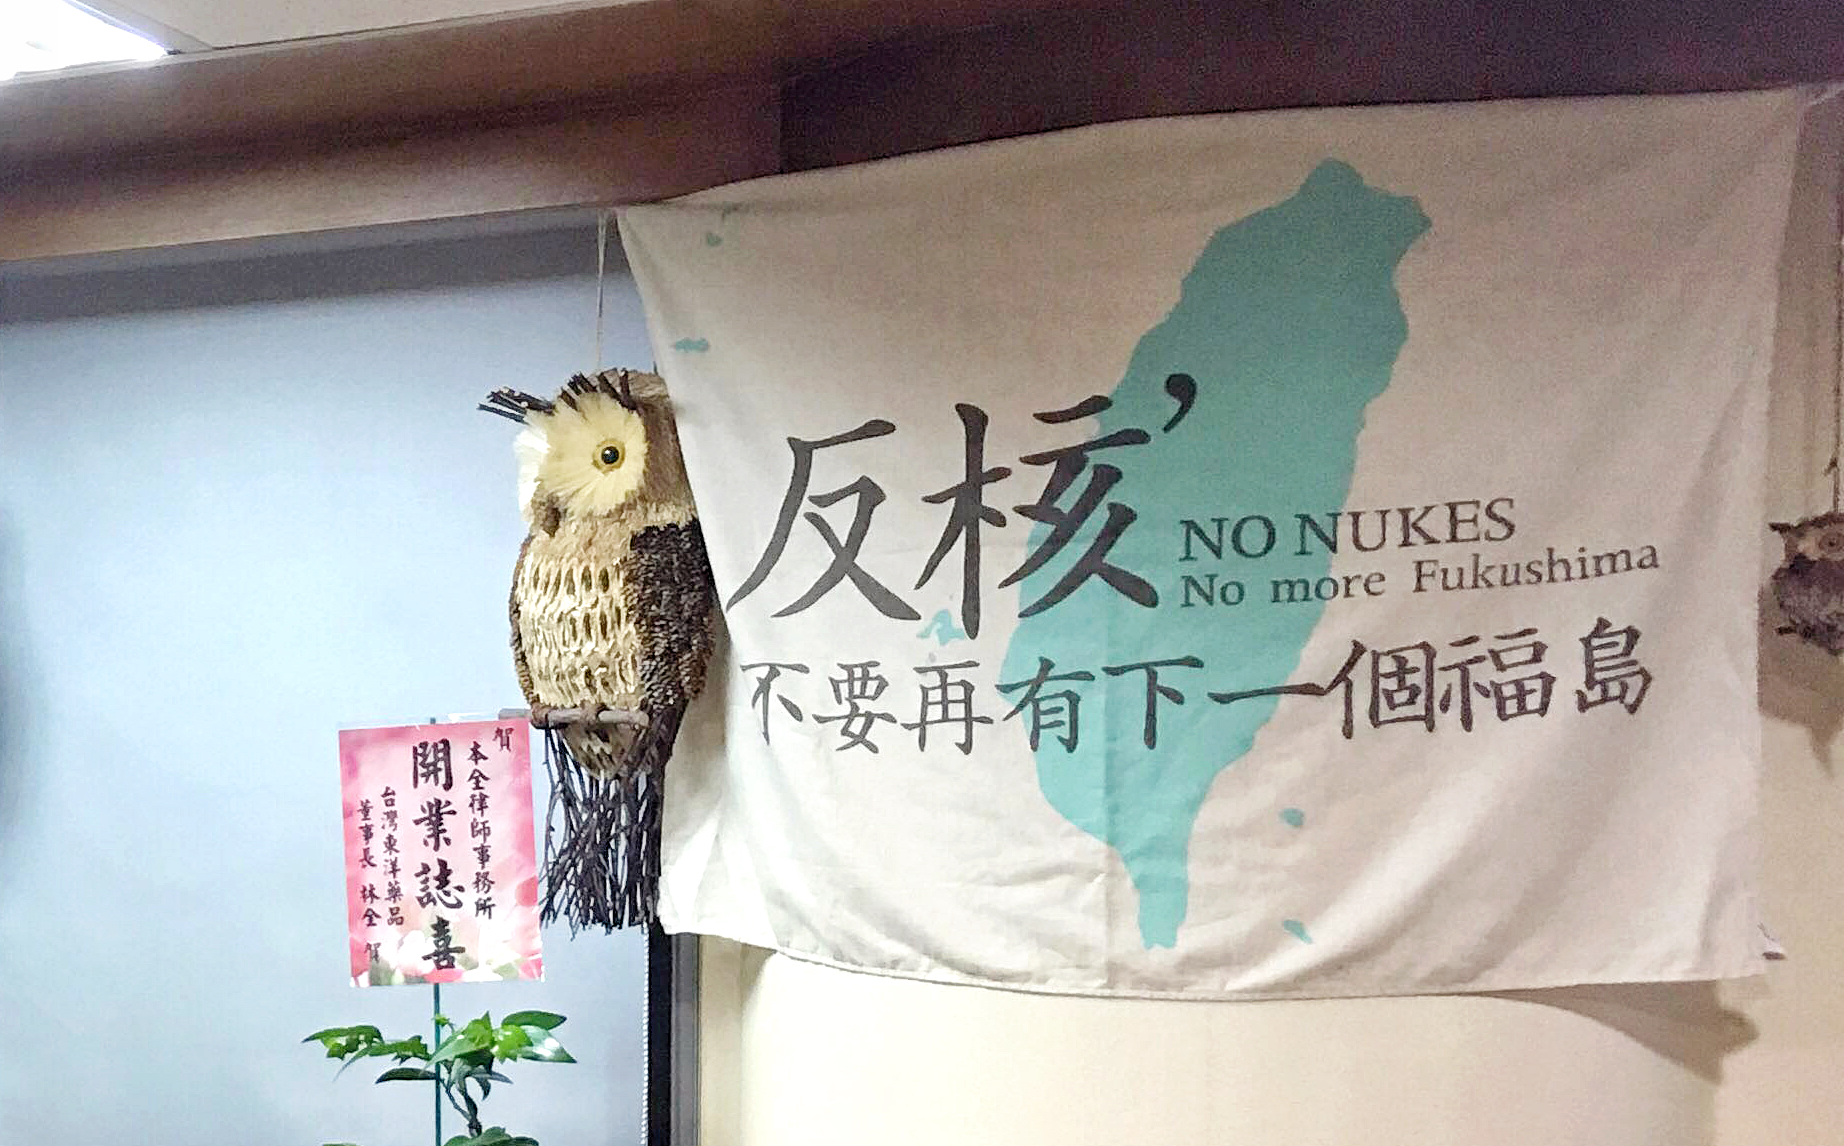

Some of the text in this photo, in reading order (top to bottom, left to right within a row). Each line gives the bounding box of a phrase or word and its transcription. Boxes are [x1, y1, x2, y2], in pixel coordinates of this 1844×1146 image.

[1178, 497, 1517, 562] NO NUKES
[1178, 540, 1659, 609] No more Fukushima
[740, 615, 1651, 756] 不要再有下一個福島
[492, 726, 514, 752] 賀
[357, 799, 377, 868] 董事長
[380, 786, 404, 926] 台灣東洋藥品
[412, 738, 466, 971] 開業誌喜
[466, 741, 496, 920] 本全律師事務所
[360, 883, 382, 927] 林全
